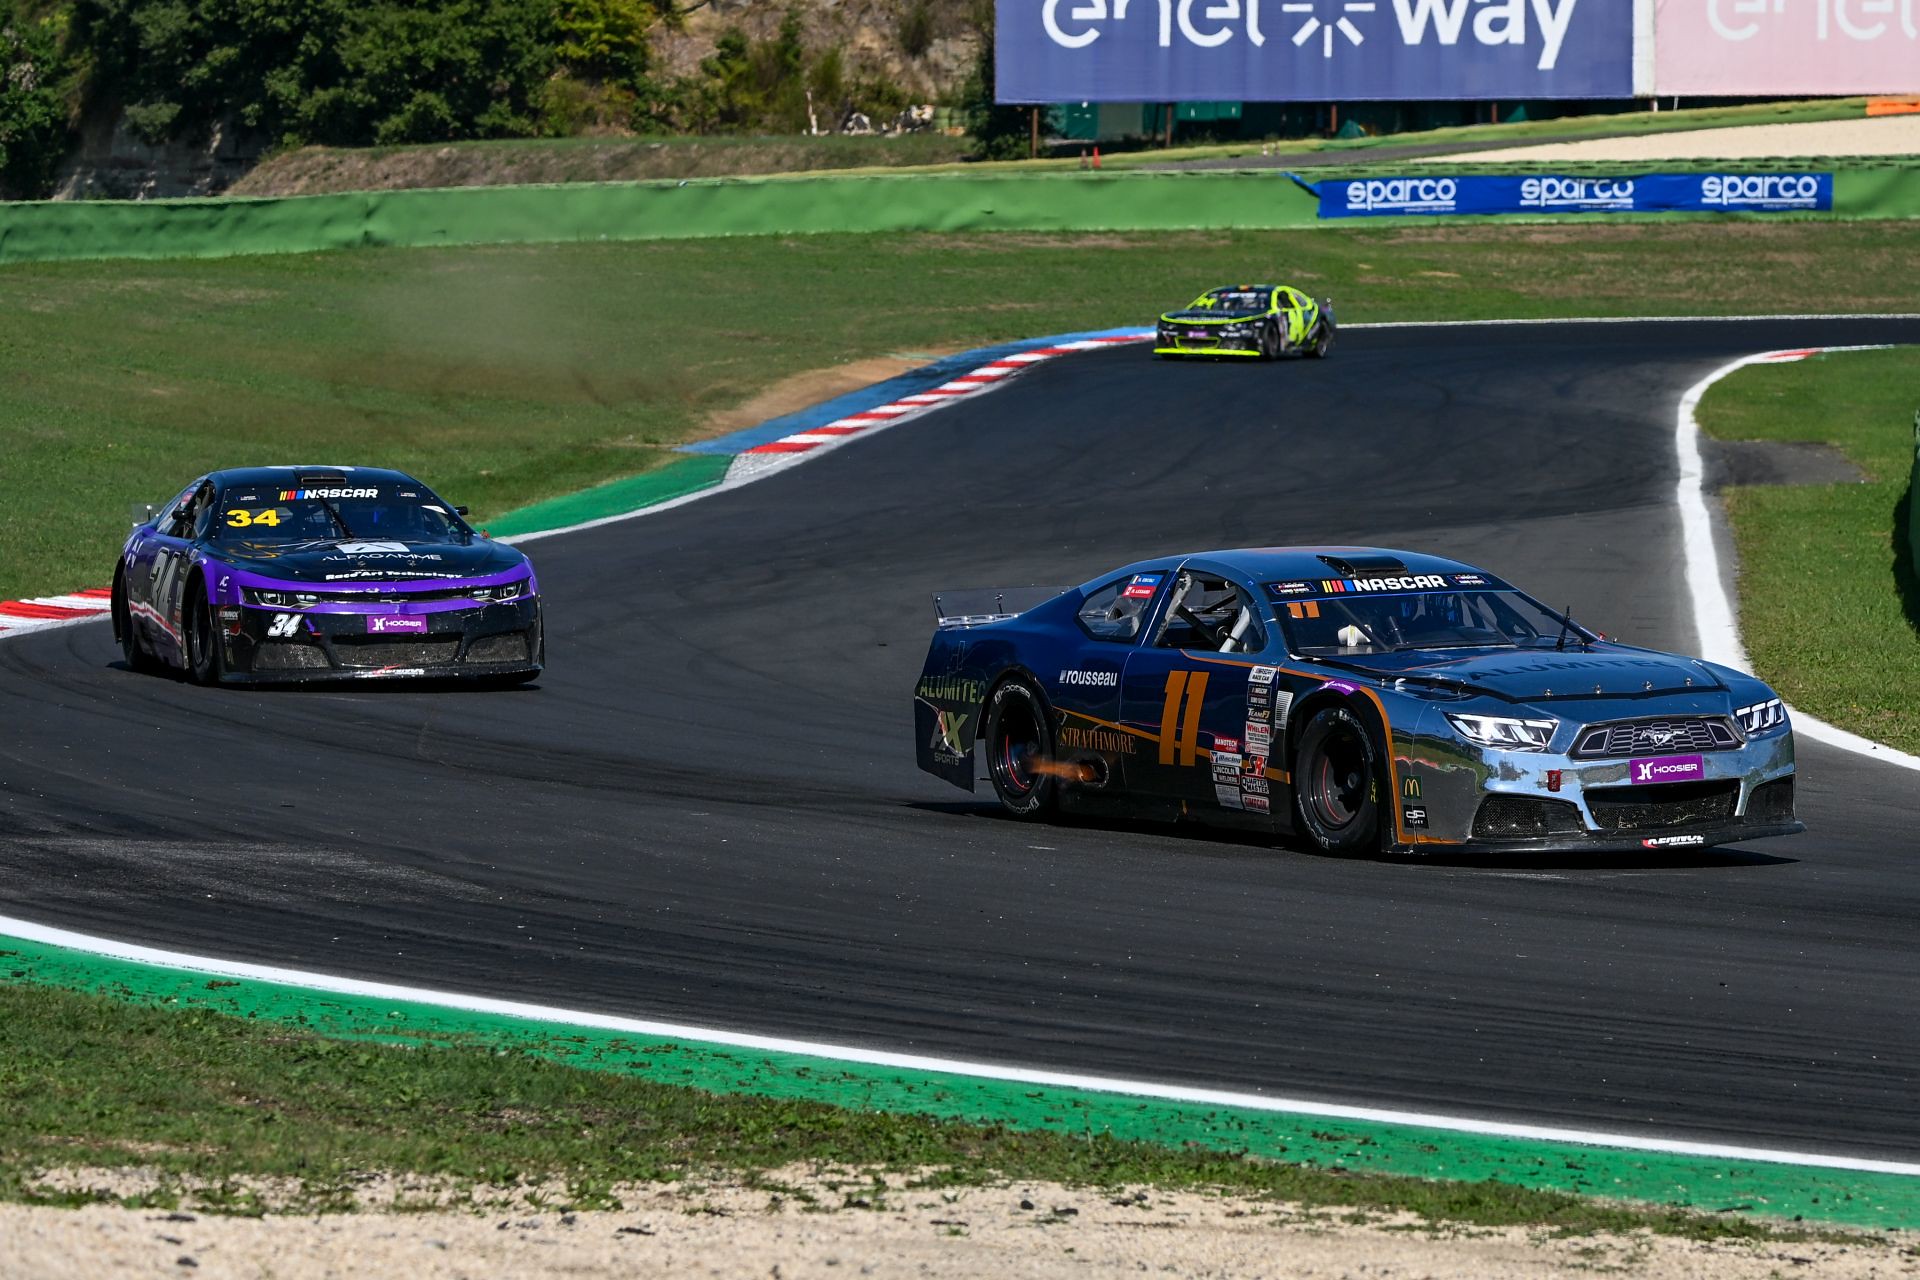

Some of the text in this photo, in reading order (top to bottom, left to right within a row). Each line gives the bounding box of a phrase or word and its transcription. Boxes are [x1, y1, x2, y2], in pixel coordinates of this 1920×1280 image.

[1707, 0, 1918, 41] enel
[1042, 0, 1576, 70] enel way
[1347, 178, 1456, 210] sparco
[1702, 176, 1818, 205] sparco
[304, 488, 378, 499] NASCAR
[226, 509, 281, 527] 34
[1355, 575, 1448, 592] NASCAR
[1286, 600, 1320, 619] 11
[267, 613, 303, 637] 34
[920, 676, 985, 704] ALUMITEC
[1066, 670, 1118, 686] rousseau
[1159, 670, 1210, 767] 11
[1061, 726, 1137, 754] STRATHMORE
[1653, 763, 1697, 774] HOOSIER
